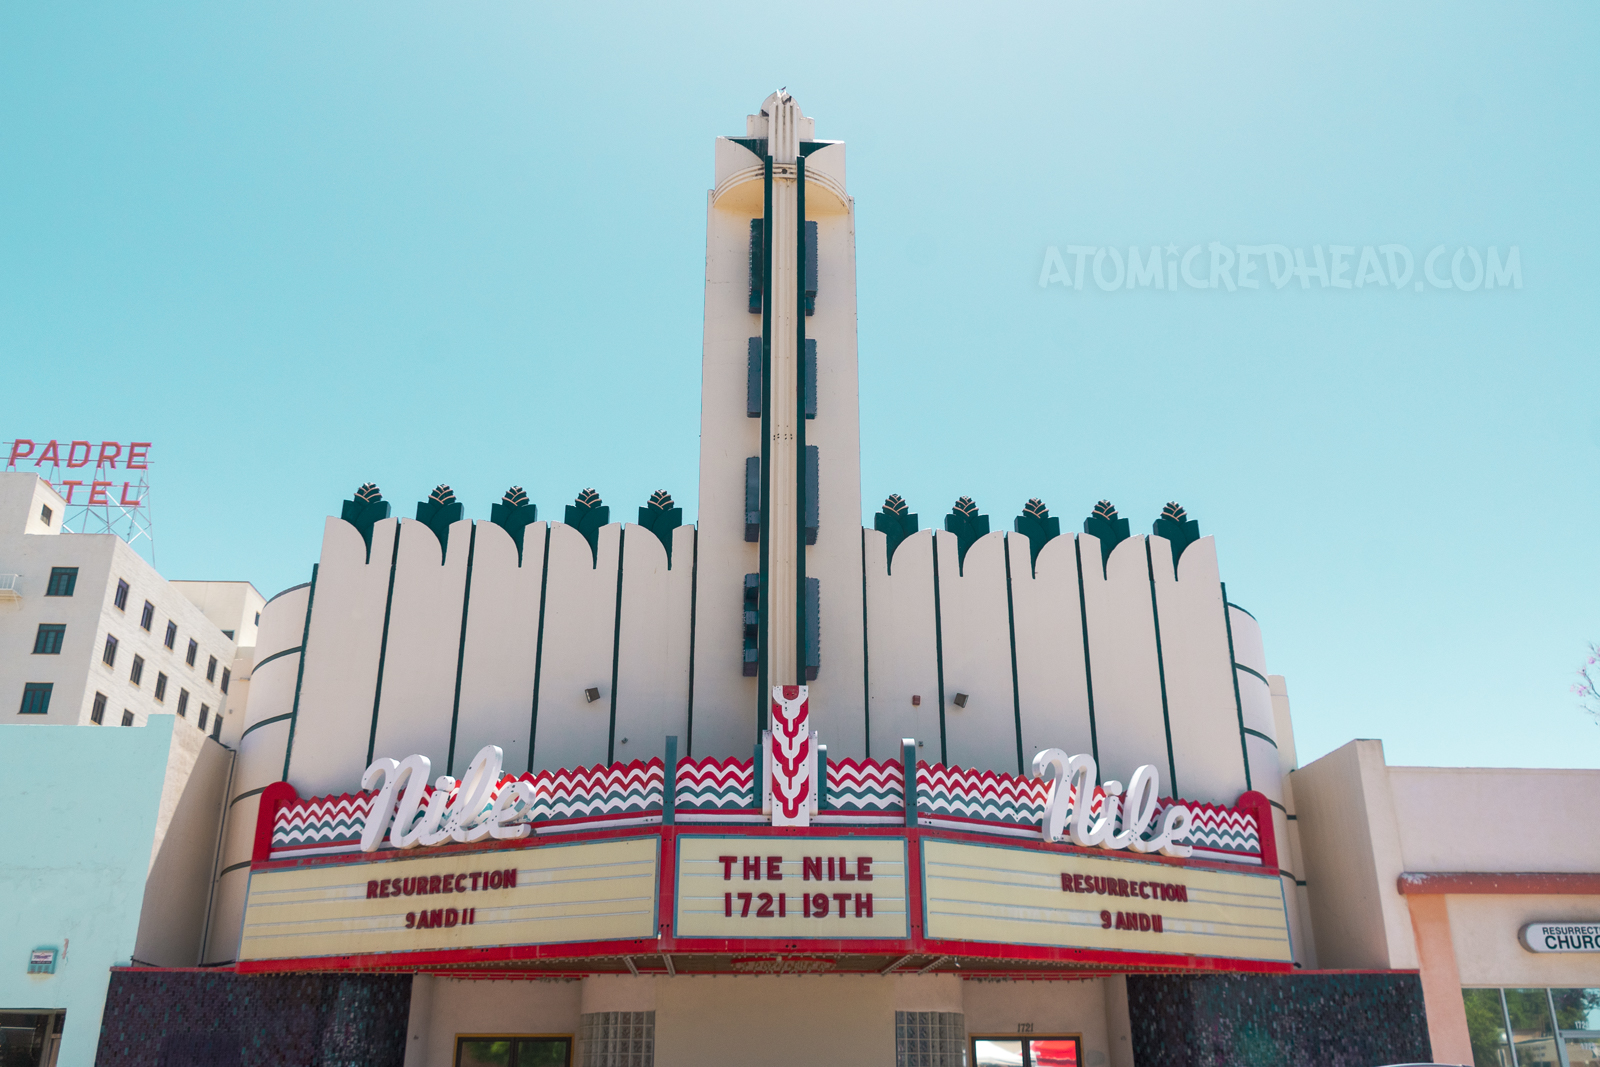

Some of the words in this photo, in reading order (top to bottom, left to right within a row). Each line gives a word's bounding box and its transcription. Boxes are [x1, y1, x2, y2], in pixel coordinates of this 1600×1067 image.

[8, 439, 152, 469] PADRE
[44, 480, 141, 505] TEL
[360, 745, 536, 853] Nile
[1032, 748, 1193, 858] Nile
[719, 856, 783, 881] THE
[803, 856, 873, 881] NILE
[366, 868, 517, 899] RESURRECTION
[1061, 872, 1188, 902] RESURRECTION
[725, 892, 786, 918] 1721
[803, 893, 873, 918] 19TH
[1542, 926, 1600, 935] RESURRECT
[1017, 1022, 1034, 1033] 1721
